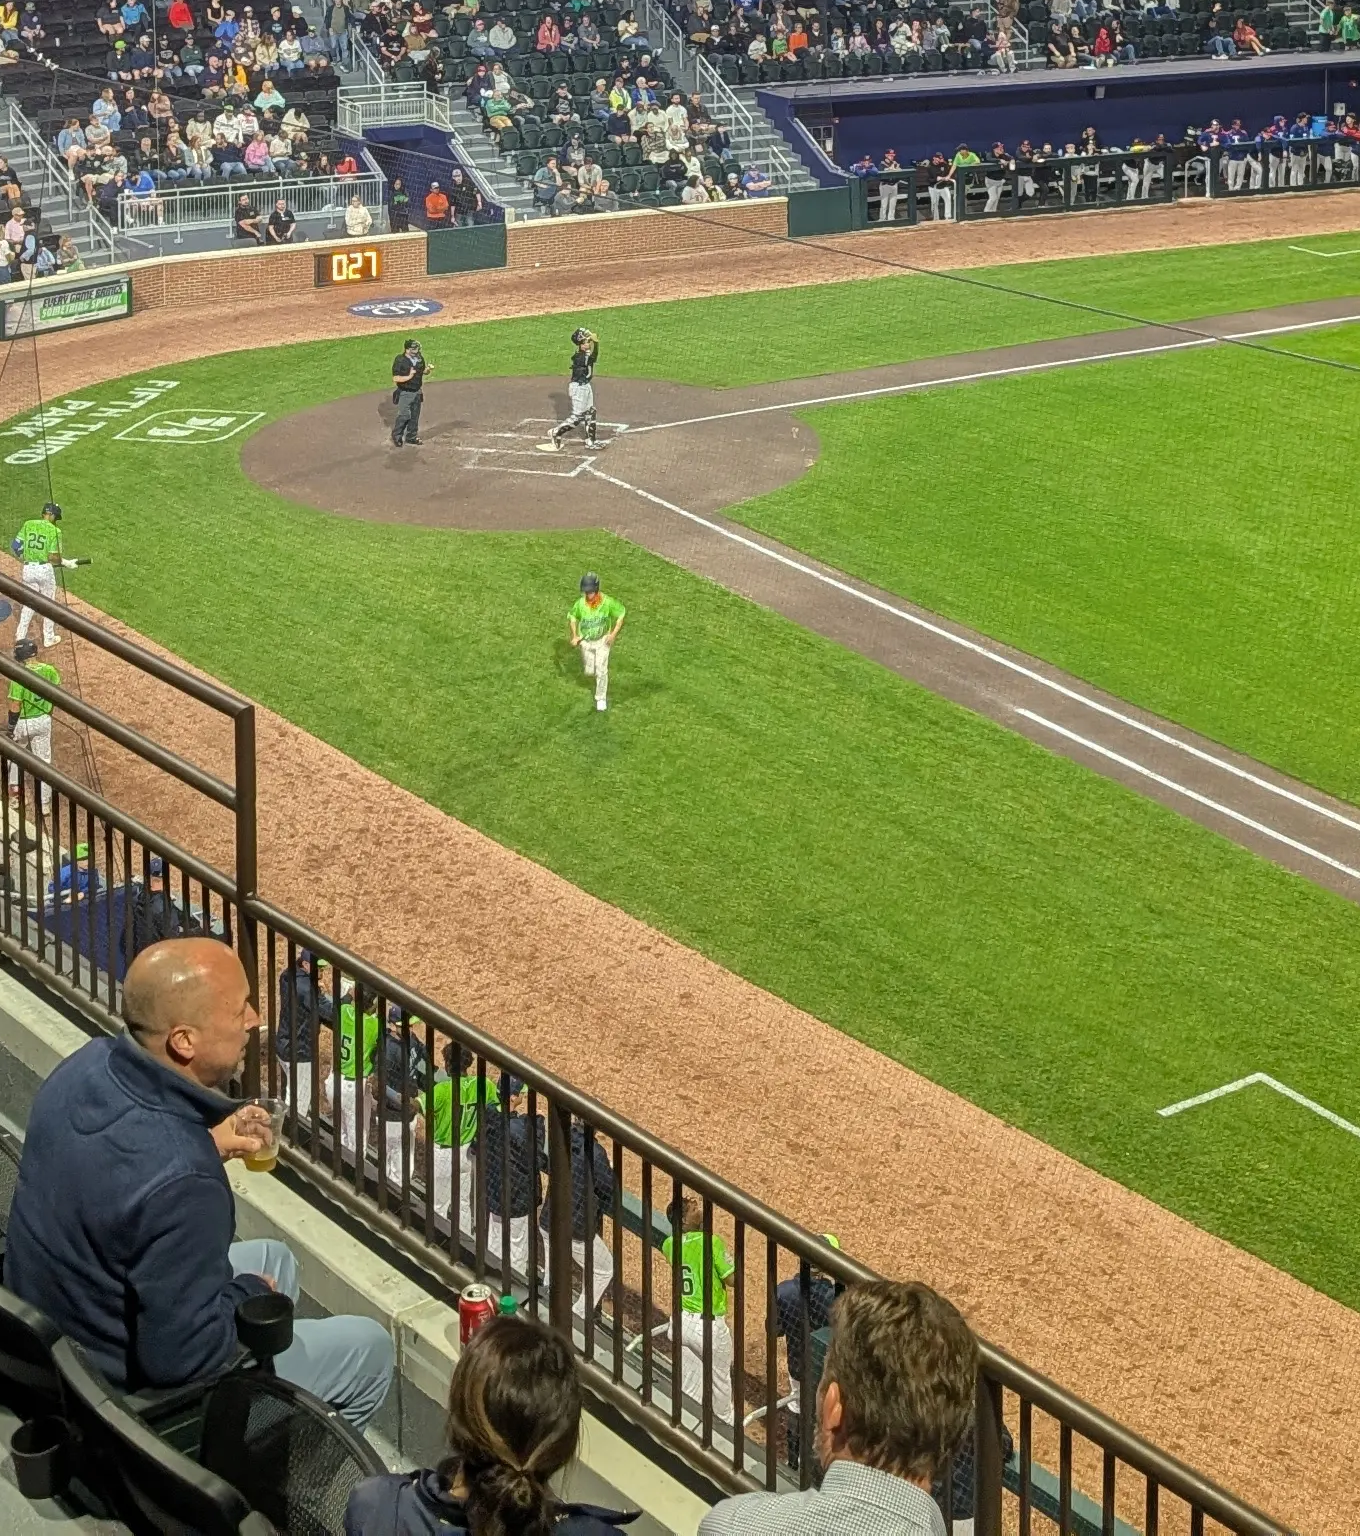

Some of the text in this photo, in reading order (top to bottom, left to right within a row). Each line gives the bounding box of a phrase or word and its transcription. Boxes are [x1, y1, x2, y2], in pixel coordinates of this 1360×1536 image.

[42, 283, 124, 309] EVERY GAME BRINGS
[42, 300, 90, 318] SOMETHING
[90, 293, 122, 310] SPECIAL
[3, 380, 181, 465] FIFTH THIRD
[27, 532, 47, 551] 25
